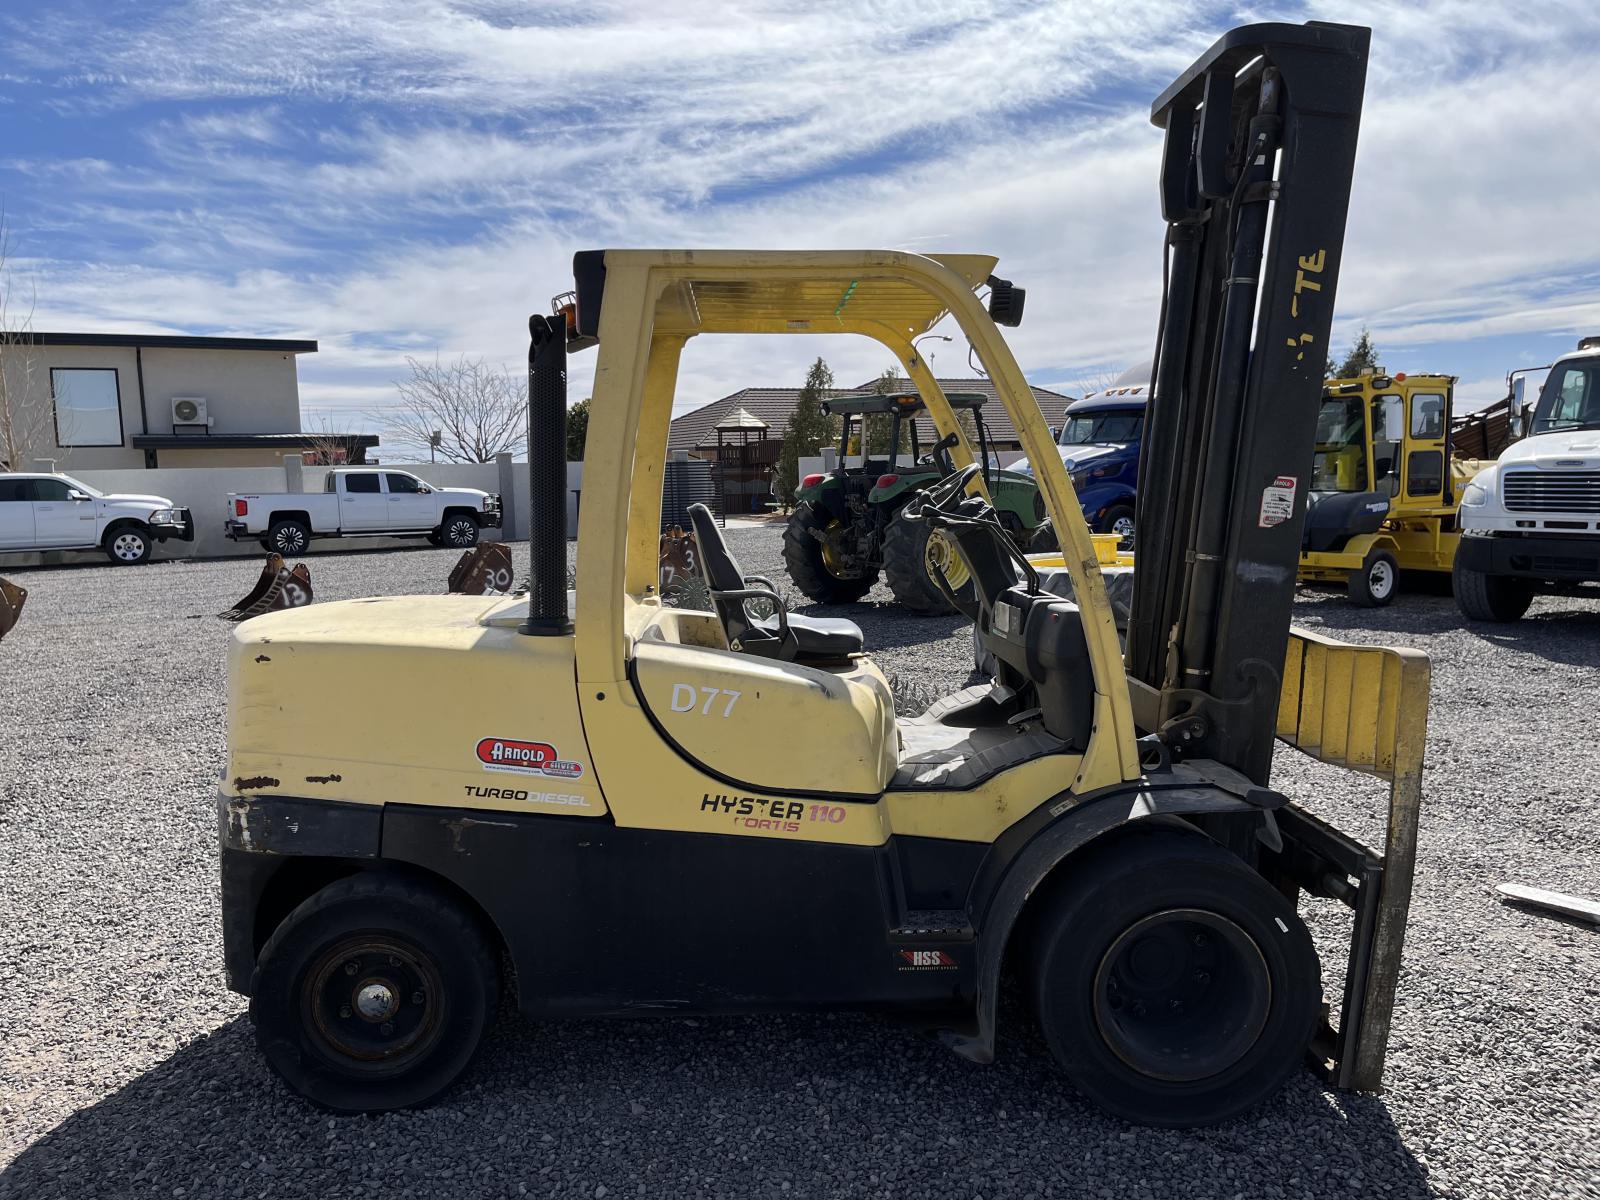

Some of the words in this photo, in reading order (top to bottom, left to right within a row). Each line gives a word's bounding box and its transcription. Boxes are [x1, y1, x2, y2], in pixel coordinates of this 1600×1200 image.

[484, 568, 510, 587] 30
[282, 583, 306, 606] 13
[671, 683, 742, 718] D77
[491, 742, 545, 762] ARNOLD
[465, 785, 591, 807] TURBODIESEL
[809, 804, 847, 824] 110
[913, 951, 940, 966] HSS
